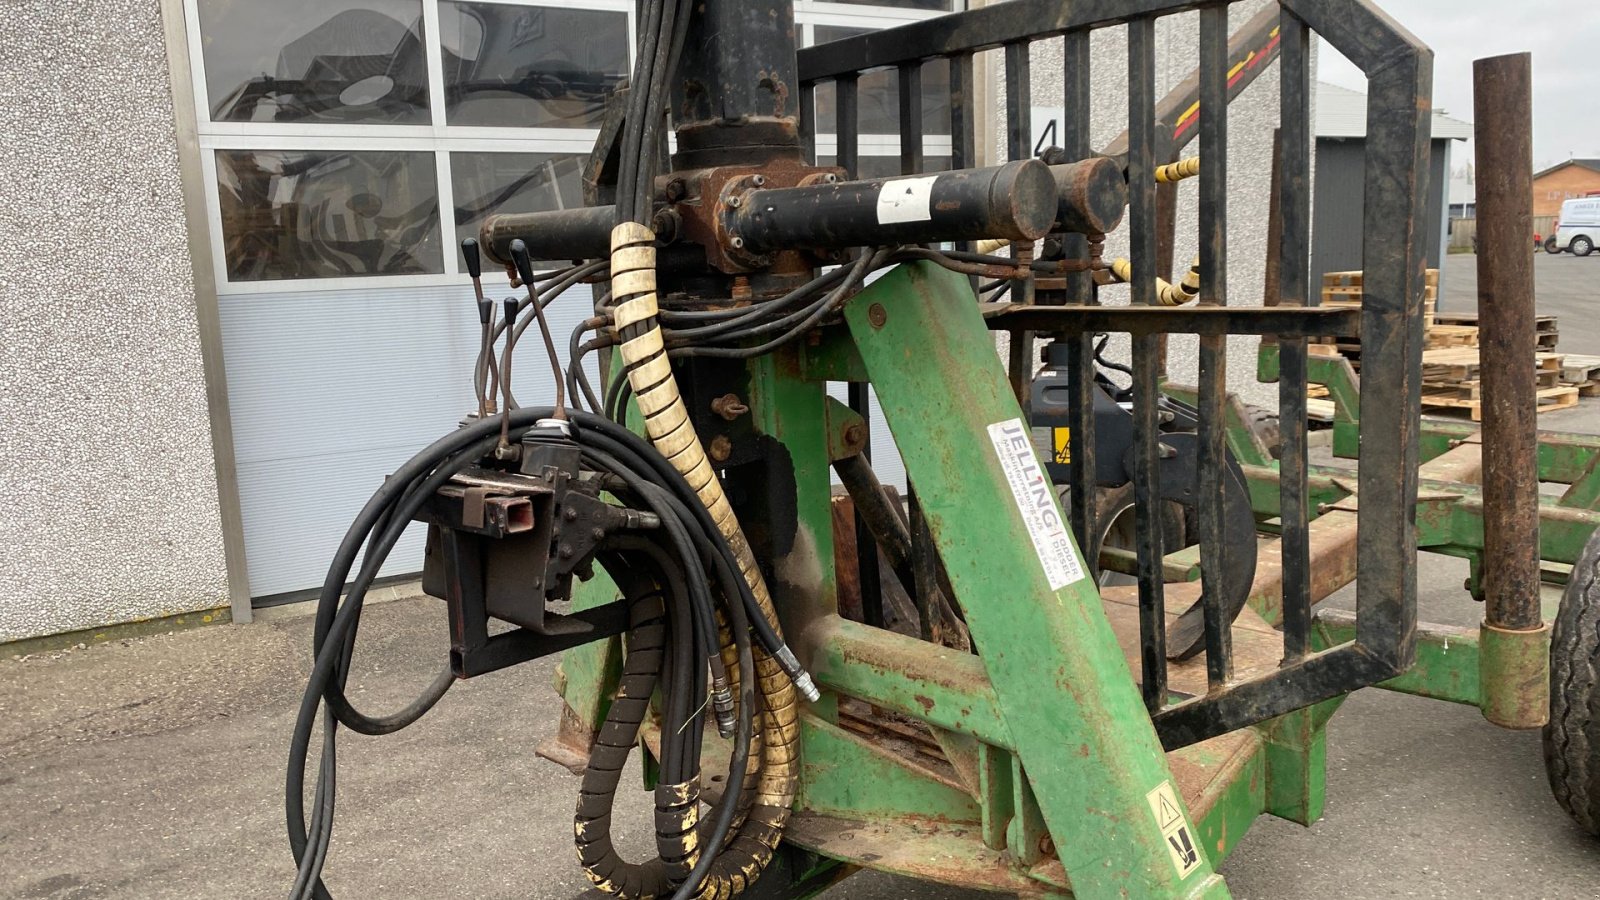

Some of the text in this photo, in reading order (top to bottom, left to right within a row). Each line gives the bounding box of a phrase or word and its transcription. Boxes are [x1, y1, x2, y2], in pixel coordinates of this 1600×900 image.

[1002, 438, 1037, 515] Maskinforretning
[1002, 427, 1058, 528] JELLING
[1060, 539, 1078, 575] ODDER
